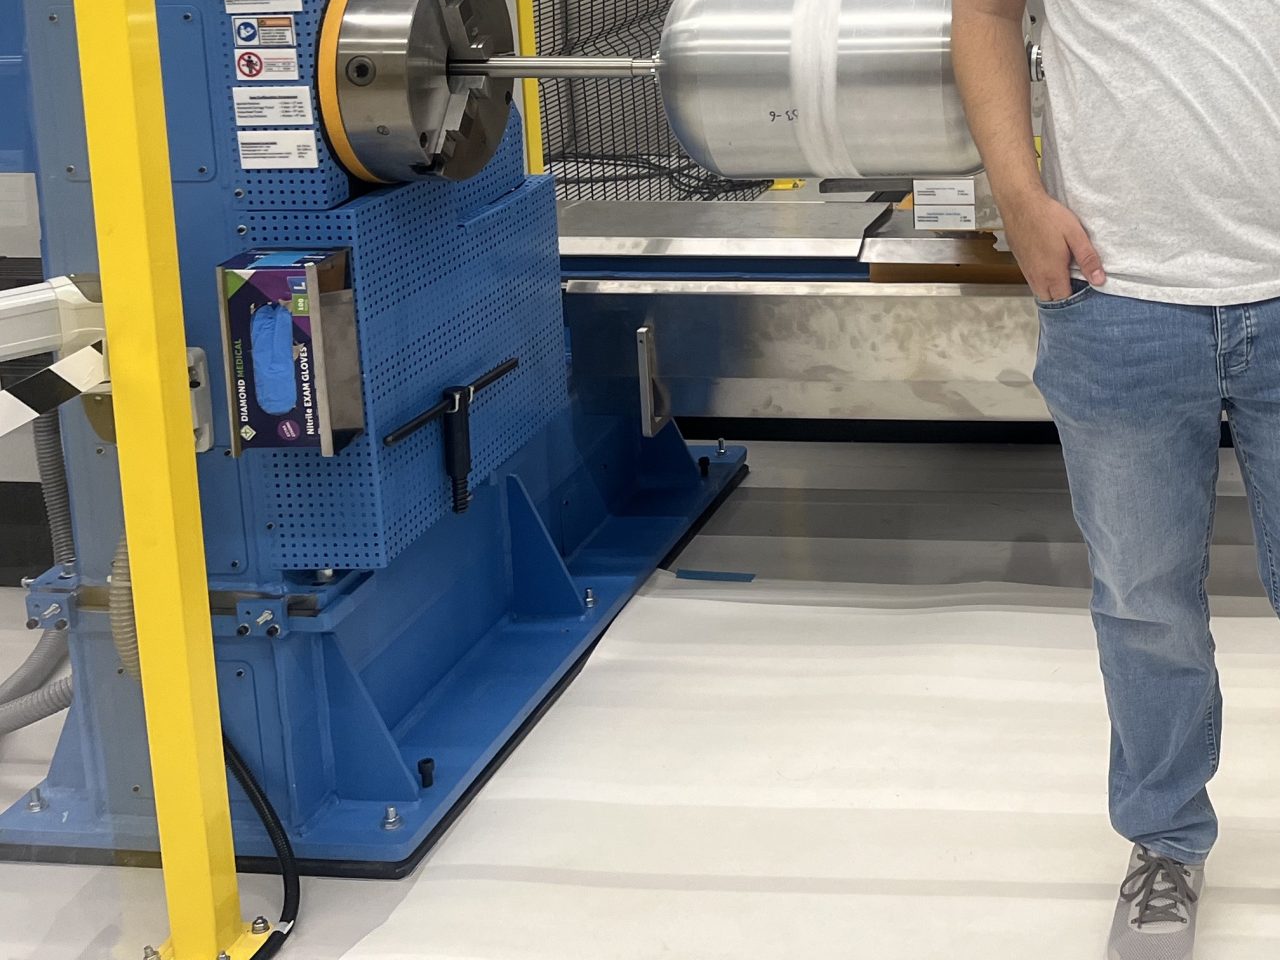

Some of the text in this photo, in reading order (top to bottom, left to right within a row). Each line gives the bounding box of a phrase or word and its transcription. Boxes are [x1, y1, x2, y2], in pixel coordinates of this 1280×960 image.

[234, 339, 249, 423] DIAMOND MEDICAL
[300, 346, 315, 435] Nitrile EXAM GLOVES
